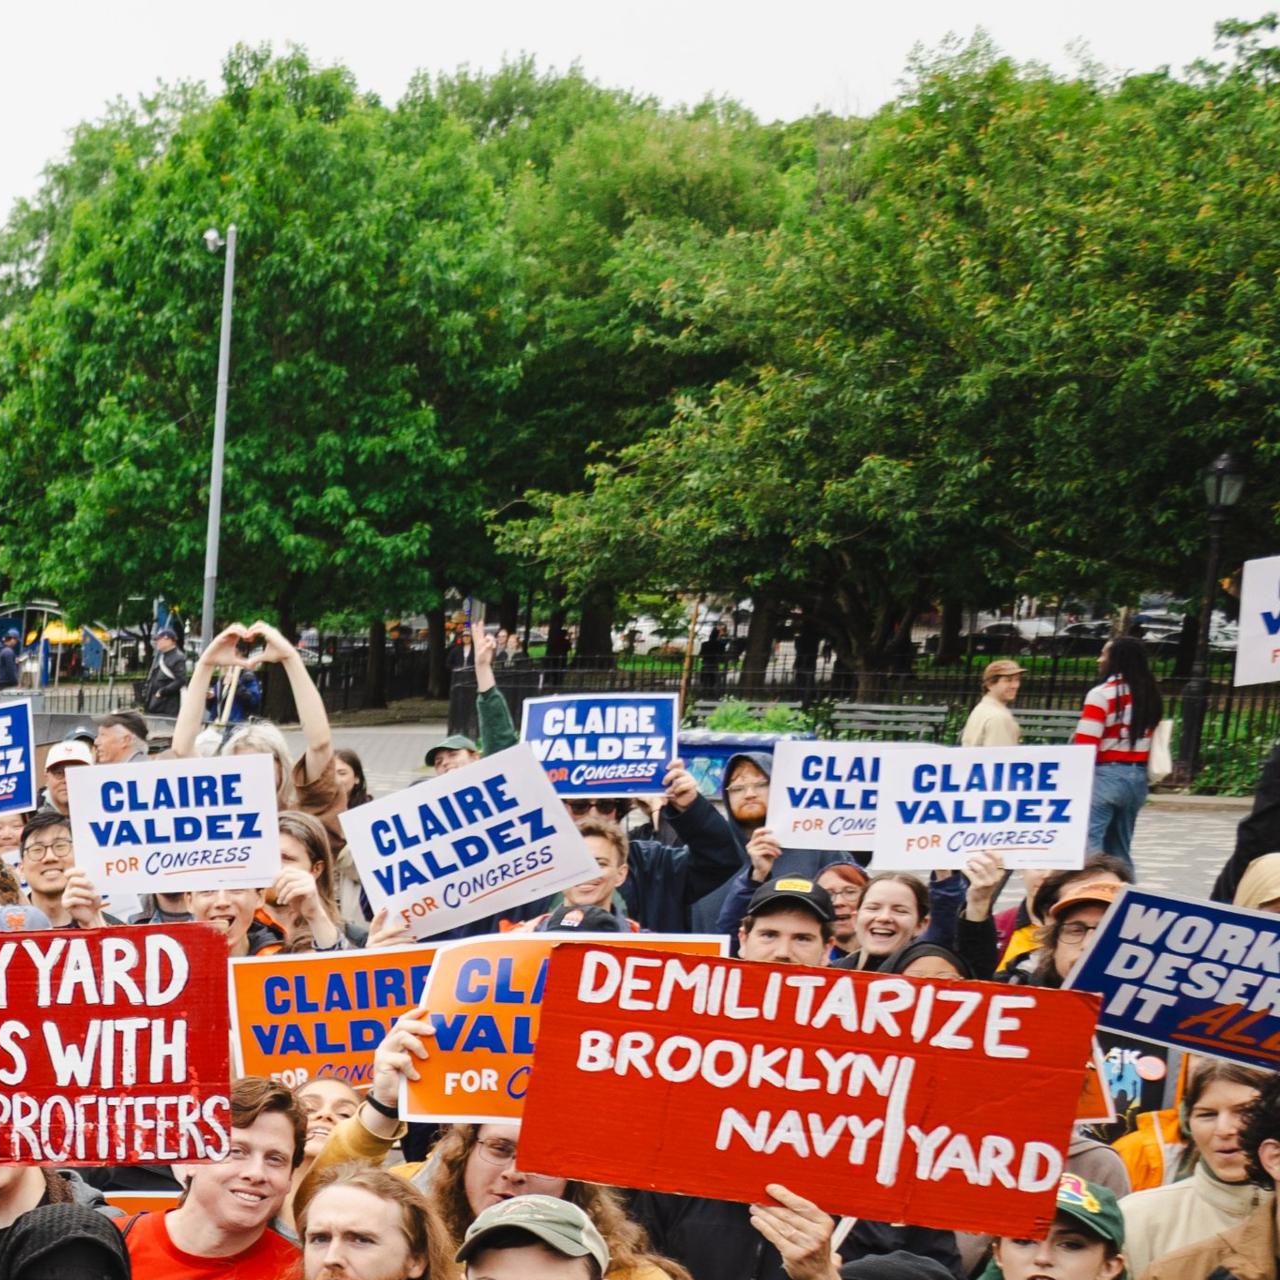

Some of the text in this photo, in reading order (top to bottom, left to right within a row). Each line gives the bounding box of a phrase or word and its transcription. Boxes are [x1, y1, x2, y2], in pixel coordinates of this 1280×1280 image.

[542, 706, 656, 736] CLAIRE
[531, 736, 667, 762] VALDEZ
[545, 769, 568, 783] OR
[801, 755, 881, 783] CLAI
[912, 761, 1060, 793] CLAIRE
[101, 773, 243, 813] CLAIRE
[786, 787, 878, 810] VALD
[371, 774, 519, 857] CLAIRE
[792, 816, 876, 835] FOR CONG
[897, 799, 1072, 824] VALDEZ
[89, 812, 263, 847] VALDEZ
[905, 835, 941, 852] FOR
[105, 857, 140, 875] FOR
[373, 808, 557, 896] VALDEZ
[399, 896, 439, 924] FOR
[1118, 903, 1280, 974] WORK
[21, 934, 189, 1008] YARD
[1104, 942, 1280, 1018] DESER
[577, 950, 1036, 1058] DEMILITARIZE
[1104, 983, 1179, 1024] IT
[252, 1019, 396, 1055] VALD
[430, 1014, 536, 1054] VAL
[42, 1017, 188, 1089] WITH
[444, 1069, 498, 1095] FOR
[716, 1108, 1061, 1193] NAVY YARD
